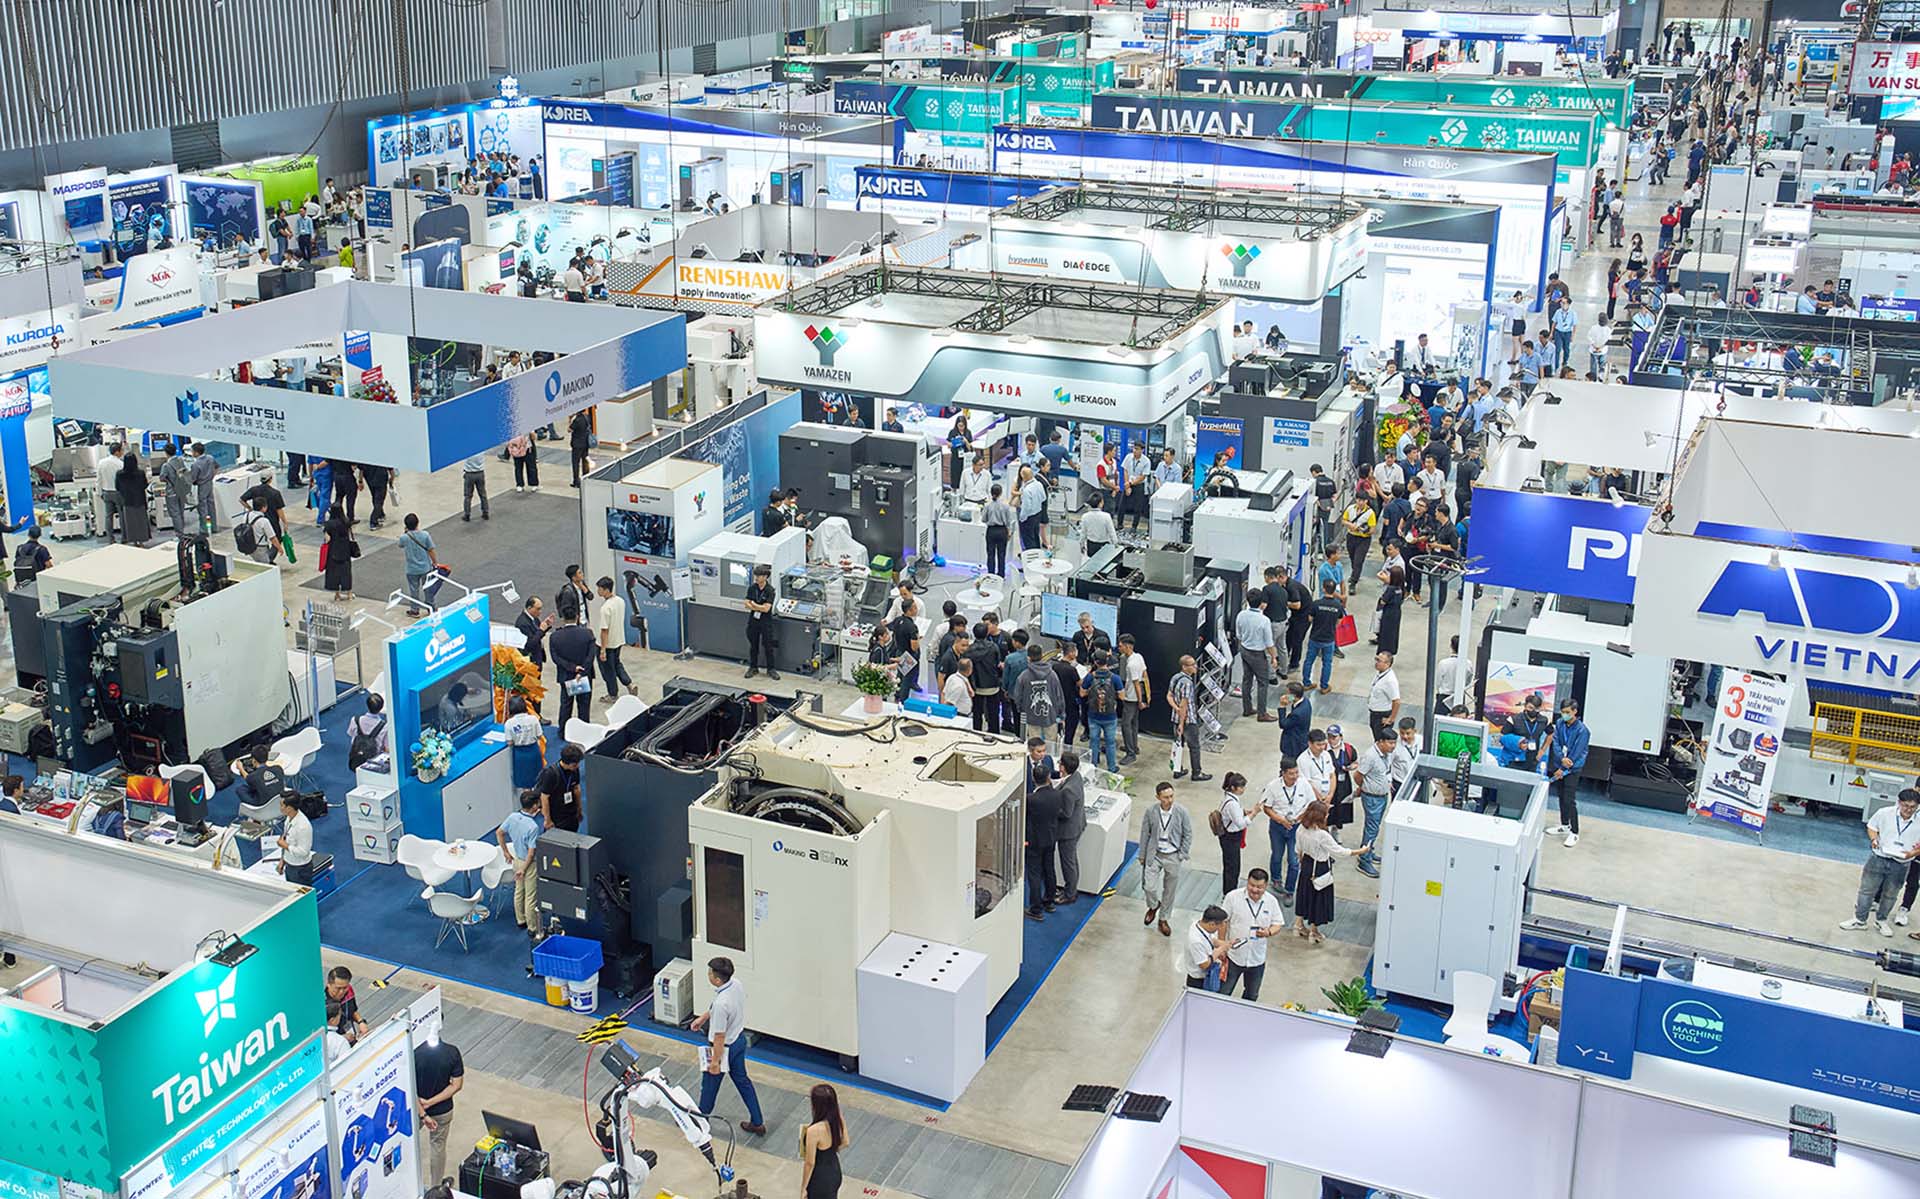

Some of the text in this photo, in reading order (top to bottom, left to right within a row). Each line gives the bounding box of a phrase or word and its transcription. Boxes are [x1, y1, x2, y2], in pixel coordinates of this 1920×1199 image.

[1197, 79, 1323, 99] TAIWAN
[1868, 76, 1901, 89] VAN
[835, 99, 887, 114] TAIWAN
[1557, 96, 1617, 109] TAIWAN
[543, 106, 593, 122] KOREA
[1115, 105, 1255, 136] TAIWAN
[995, 131, 1057, 151] KOREA
[1515, 128, 1582, 145] TAIWAN
[1403, 157, 1459, 171] Hàn Quốc
[52, 178, 106, 196] MARPOSS
[859, 175, 928, 197] KOREA
[151, 271, 171, 282] KGK
[679, 265, 785, 290] RENISHAW
[1217, 277, 1262, 290] YAMAZEN
[680, 288, 704, 299] apply
[6, 324, 65, 345] KURODA
[803, 366, 852, 383] YAMAZEN
[562, 373, 594, 398] MAKINO
[980, 382, 1117, 407] YASDA HEXAGON
[1199, 420, 1242, 432] hyperMILL
[1280, 439, 1303, 447] AMANO
[1568, 526, 1640, 577] P
[1724, 685, 1745, 719] 3
[1672, 1025, 1723, 1042] MACHINE
[1672, 1032, 1700, 1044] TOOL
[152, 1011, 290, 1126] Taiwan
[375, 1067, 398, 1091] ROBOT
[180, 1134, 217, 1166] SYNTEC
[216, 1090, 271, 1139] TECHNOLOGY
